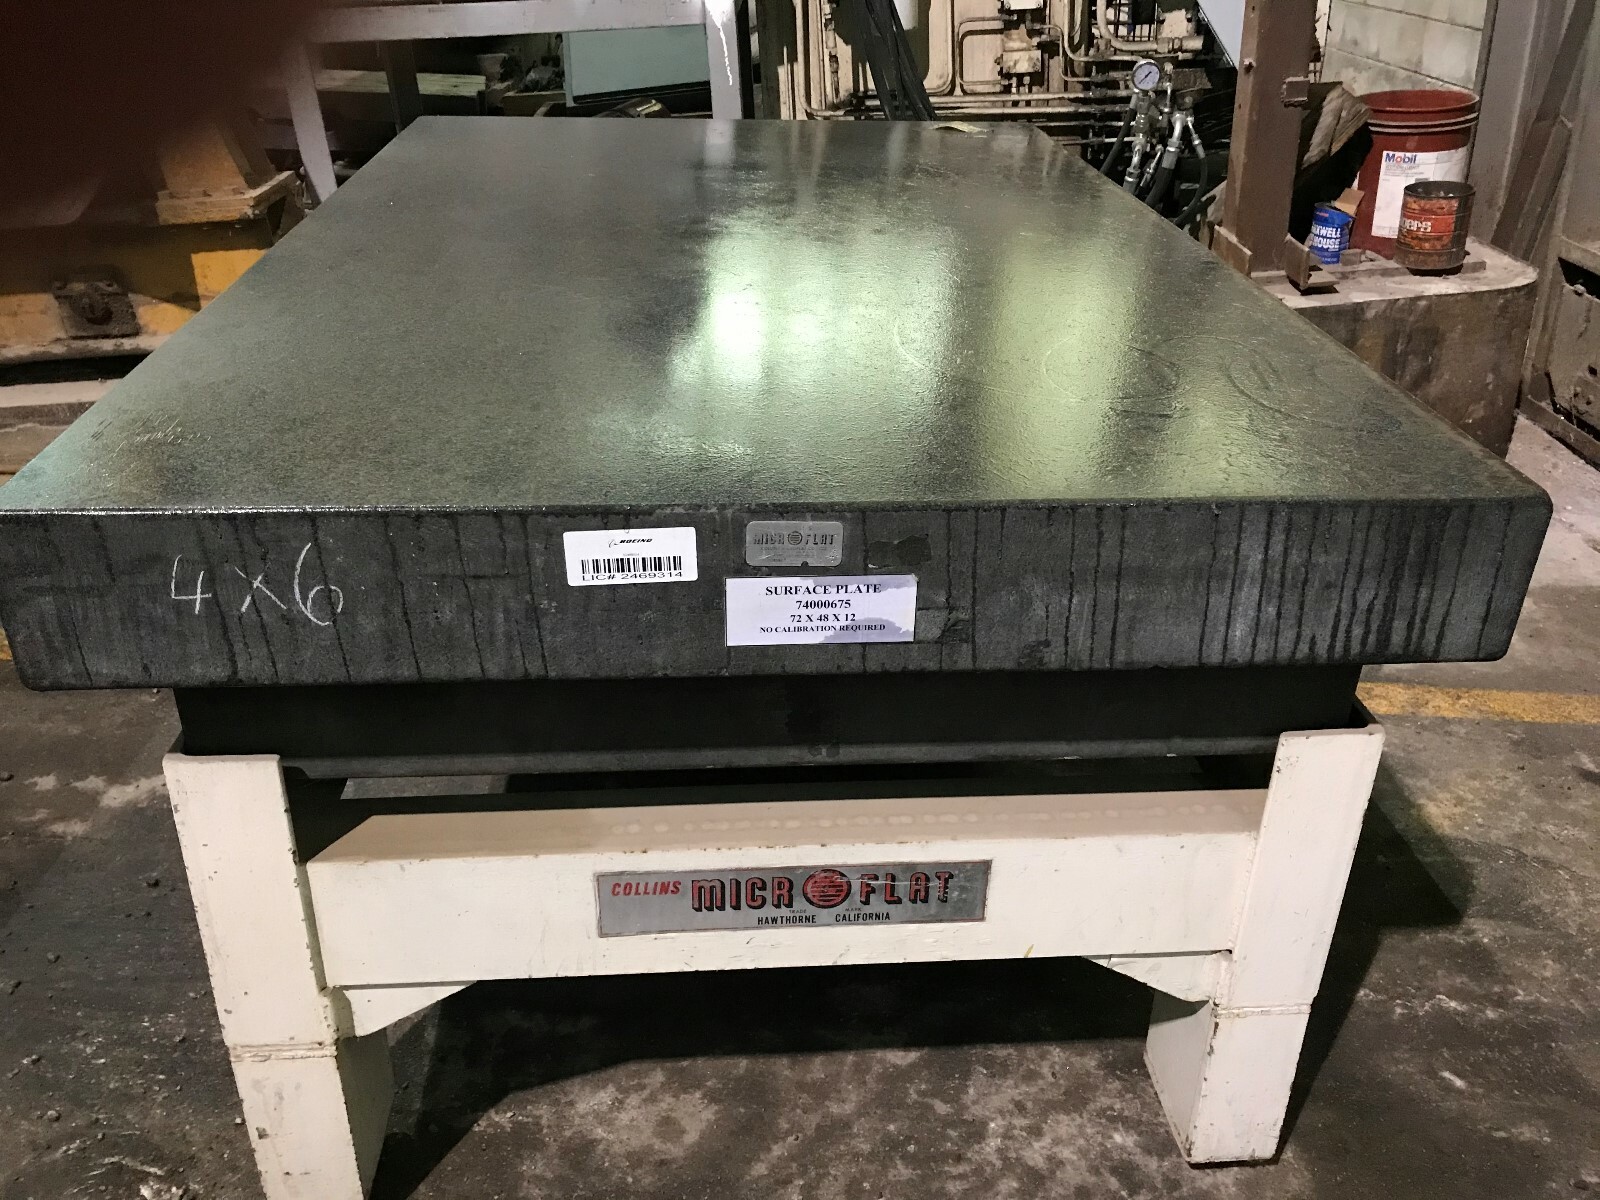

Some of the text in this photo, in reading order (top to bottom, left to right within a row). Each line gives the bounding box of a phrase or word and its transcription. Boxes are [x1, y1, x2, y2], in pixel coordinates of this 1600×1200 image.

[1385, 152, 1418, 164] Mobil
[620, 571, 683, 580] 2469314
[171, 554, 212, 615] 4
[294, 542, 344, 626] 6
[765, 583, 882, 596] SURFACE PLATE
[795, 599, 851, 610] 74000675
[790, 613, 856, 623] 72 X 48 X 12
[775, 625, 837, 633] CALIBRATION
[839, 624, 886, 632] REQUIRED
[610, 880, 682, 897] COLLINS
[757, 911, 891, 926] HAWTHORNE CALIFORNIA
